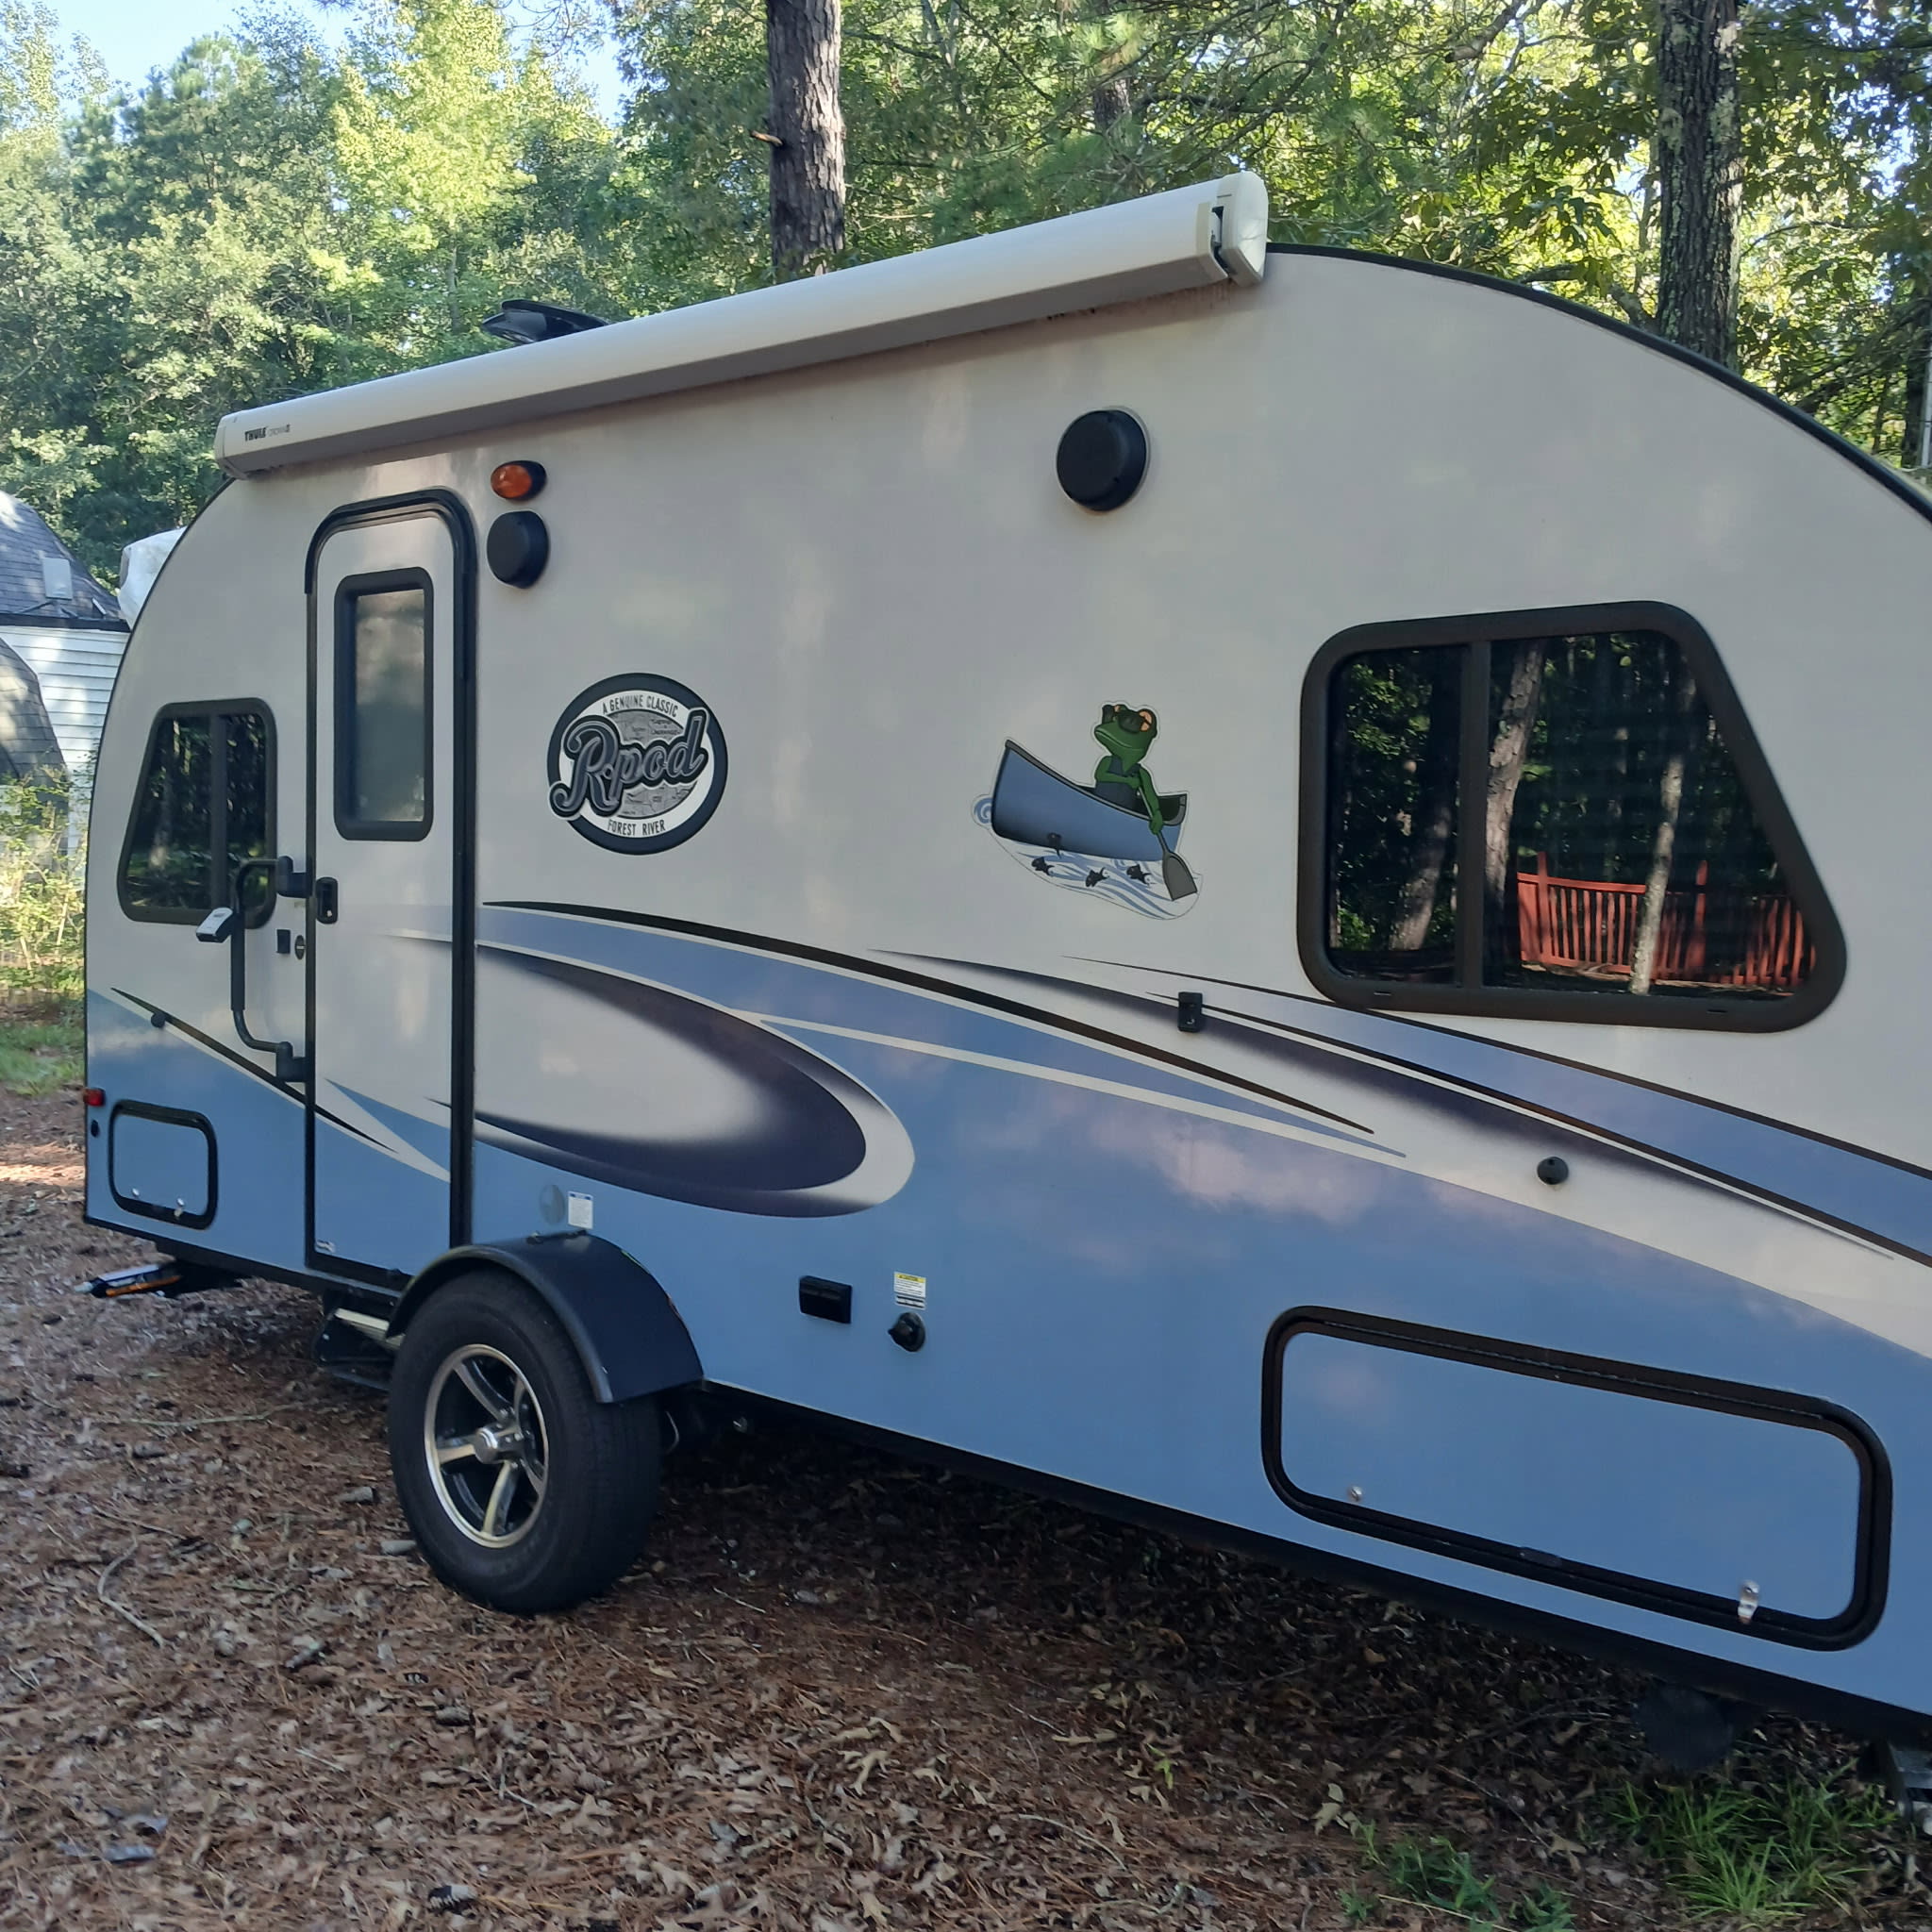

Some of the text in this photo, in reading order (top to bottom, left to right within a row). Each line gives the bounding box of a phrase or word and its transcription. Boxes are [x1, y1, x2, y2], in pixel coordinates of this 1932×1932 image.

[602, 694, 678, 717] A GENUINE CLASSIC
[608, 819, 666, 836] FOREST RIVER
